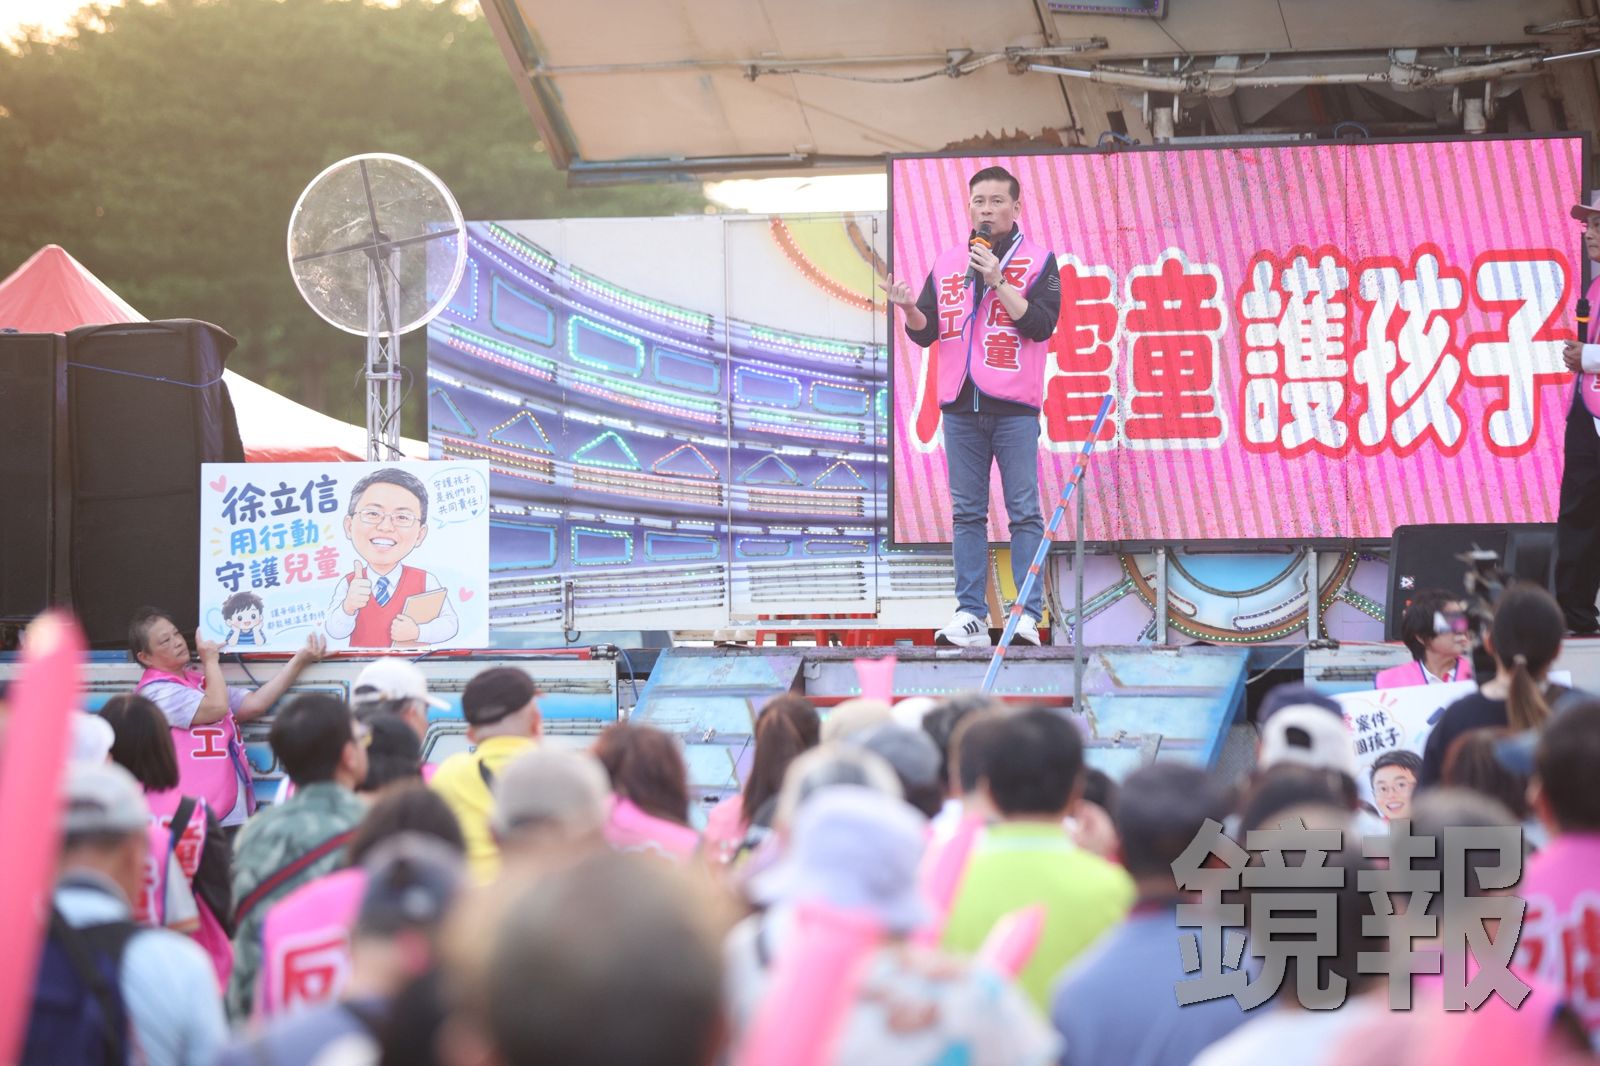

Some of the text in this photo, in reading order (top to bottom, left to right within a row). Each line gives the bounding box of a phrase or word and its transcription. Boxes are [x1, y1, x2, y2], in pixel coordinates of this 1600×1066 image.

[940, 272, 965, 341] 志工
[221, 474, 339, 525] 徐立信
[230, 519, 319, 556] 用行動
[215, 546, 340, 592] 守護兒童
